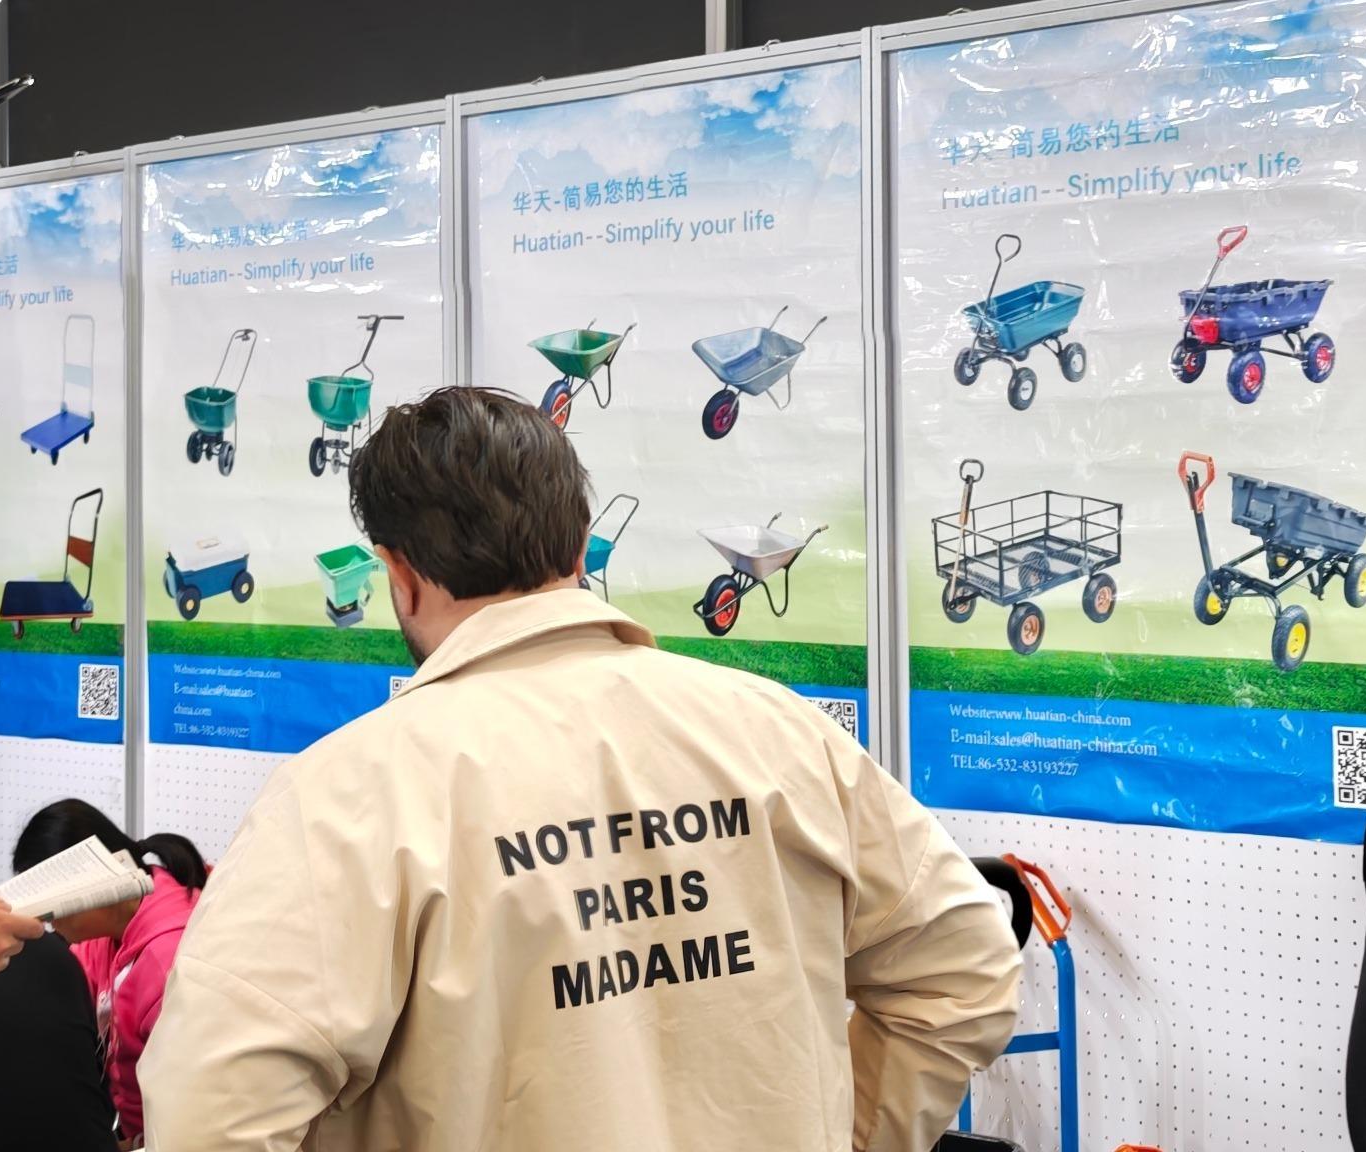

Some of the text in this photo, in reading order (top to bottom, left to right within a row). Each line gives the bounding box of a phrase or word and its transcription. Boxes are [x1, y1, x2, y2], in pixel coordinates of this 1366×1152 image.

[512, 170, 689, 217] 华天-简易您的生活
[1185, 160, 1248, 193] your
[1258, 151, 1302, 180] life
[512, 209, 775, 254] Huatian--Simplify your life
[170, 251, 375, 287] Huatian--Simplify your life
[19, 292, 51, 310] your
[53, 285, 74, 303] life
[494, 797, 751, 877] NOT FROM
[573, 870, 709, 931] PARIS
[551, 930, 756, 1010] MADAME
